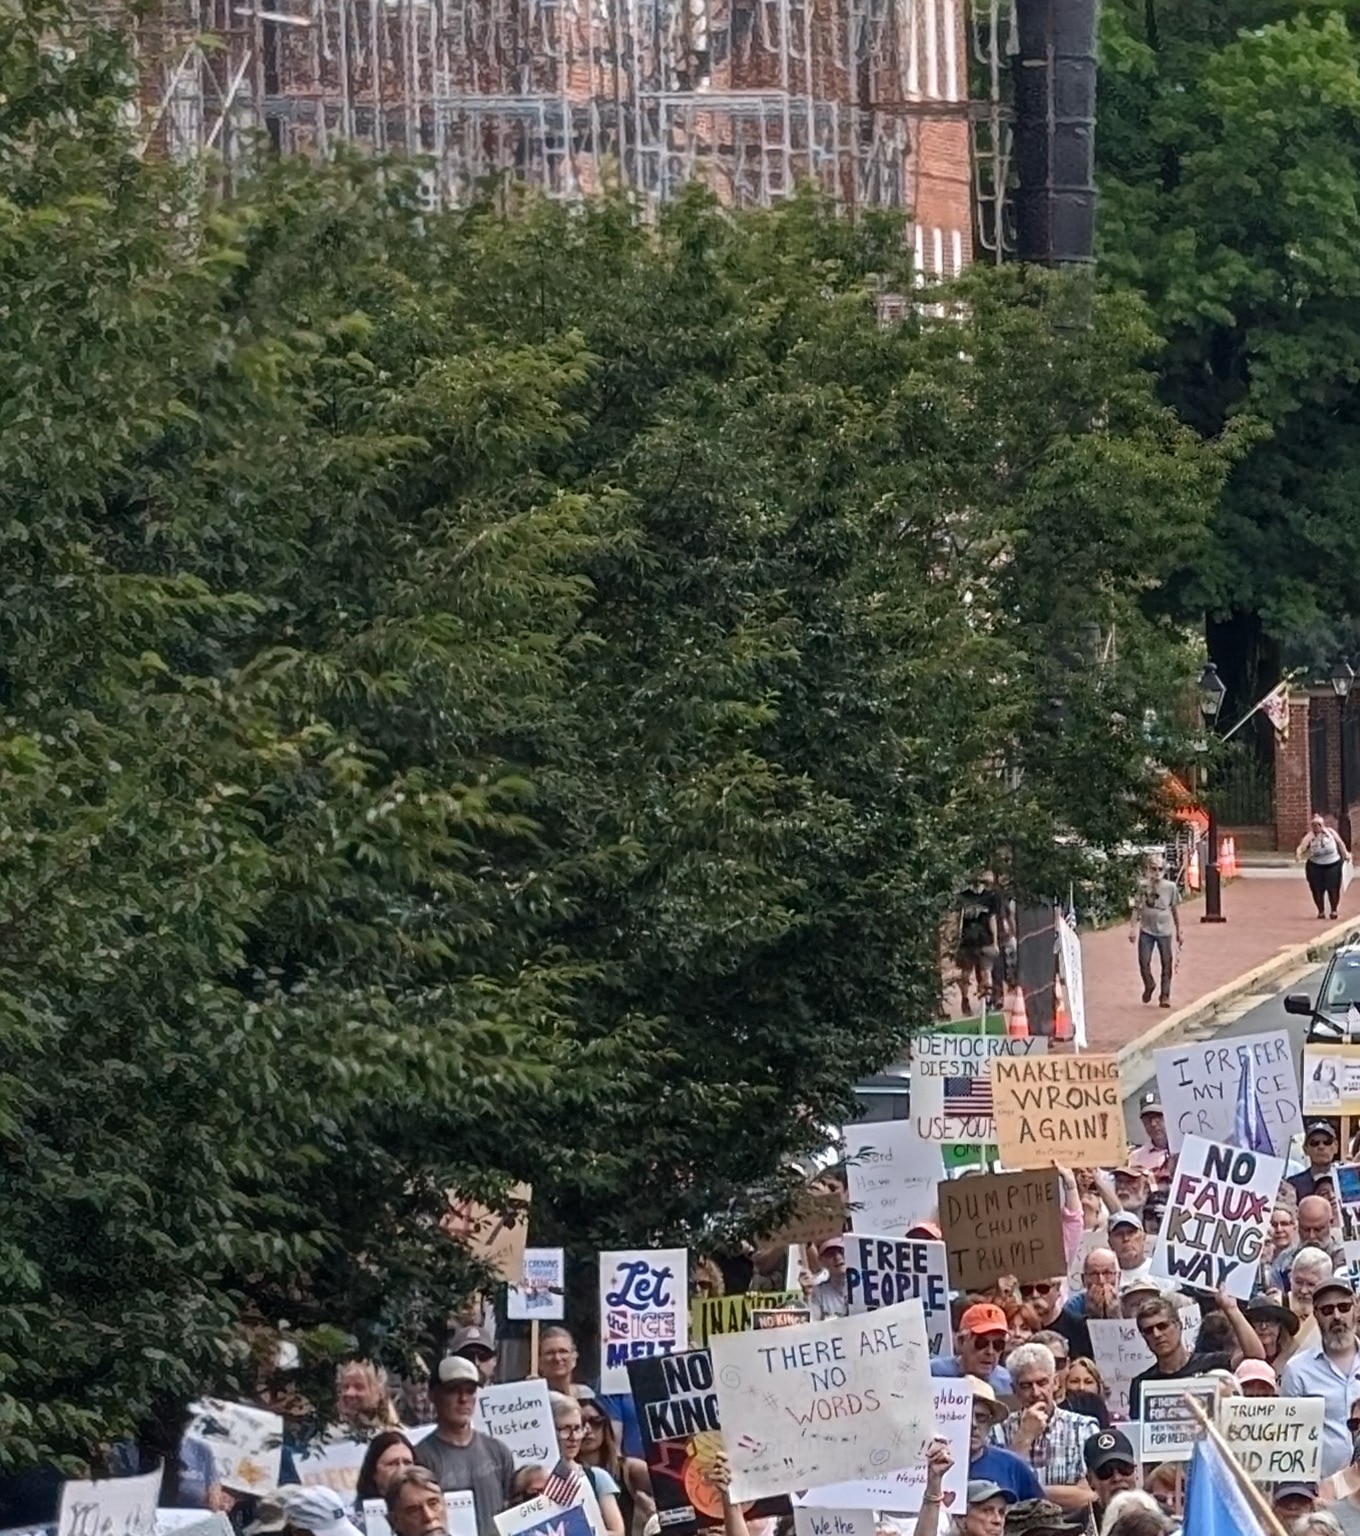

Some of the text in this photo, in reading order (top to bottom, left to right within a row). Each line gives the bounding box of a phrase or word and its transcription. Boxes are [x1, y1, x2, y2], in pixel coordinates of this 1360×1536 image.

[997, 1060, 1119, 1082] MAKE LYING
[1173, 1057, 1193, 1086] I
[1011, 1086, 1117, 1110] WRONG
[1193, 1083, 1224, 1101] MY
[917, 1117, 952, 1139] USE
[1020, 1113, 1108, 1143] AGAIN!
[1202, 1144, 1257, 1184] NO
[949, 1183, 1053, 1225] DUMP THE
[975, 1214, 1037, 1239] CHUMP
[1166, 1207, 1265, 1263] KING
[859, 1238, 928, 1273] FREE
[952, 1240, 1045, 1276] TRUMP
[1166, 1244, 1239, 1289] WAY
[606, 1260, 674, 1311] Let
[846, 1267, 945, 1310] PEOPLE
[606, 1311, 676, 1339] the ICE
[758, 1323, 903, 1373] THERE ARE
[662, 1355, 716, 1394] NO
[812, 1366, 846, 1392] NO
[479, 1397, 542, 1417] Freedom
[786, 1389, 881, 1426] WORDS
[1231, 1405, 1296, 1418] TRUMP IS
[1309, 1427, 1319, 1440] &
[520, 1500, 544, 1517] GIVE
[811, 1516, 855, 1535] We the
